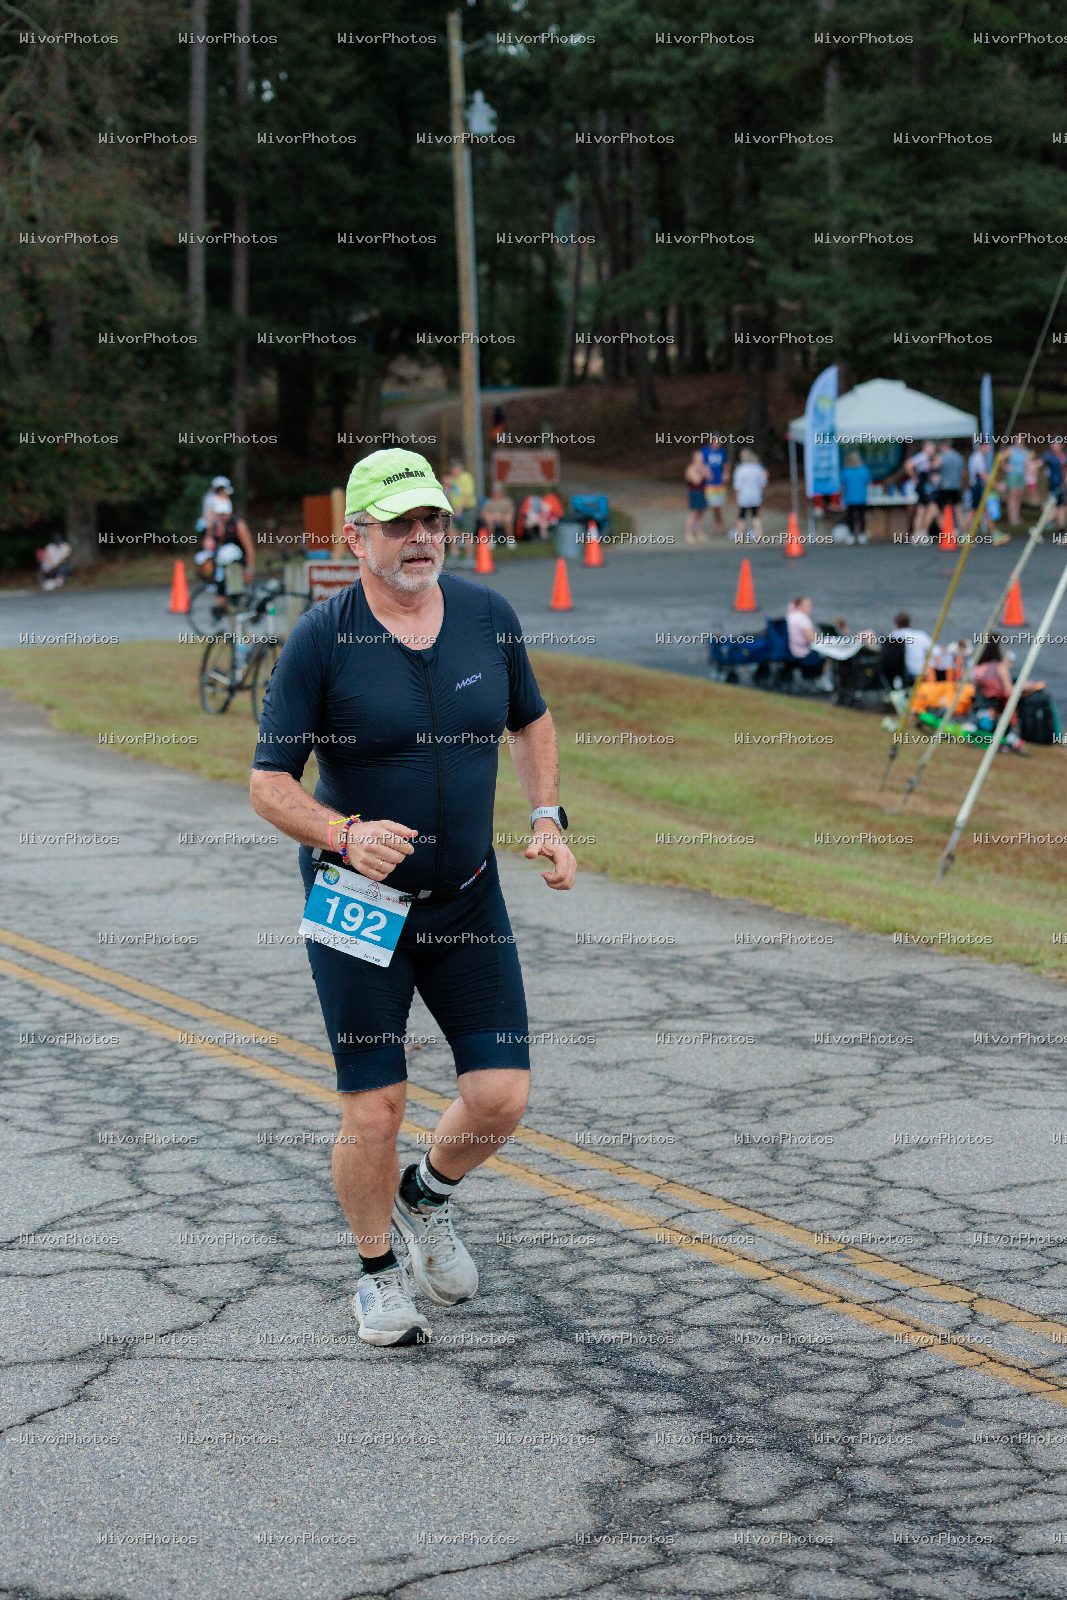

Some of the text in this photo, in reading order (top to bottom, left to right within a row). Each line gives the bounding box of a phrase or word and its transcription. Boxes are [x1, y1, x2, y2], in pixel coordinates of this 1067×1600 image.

[383, 468, 426, 486] IRONMAN
[455, 673, 482, 691] MACH
[326, 896, 388, 942] 192
